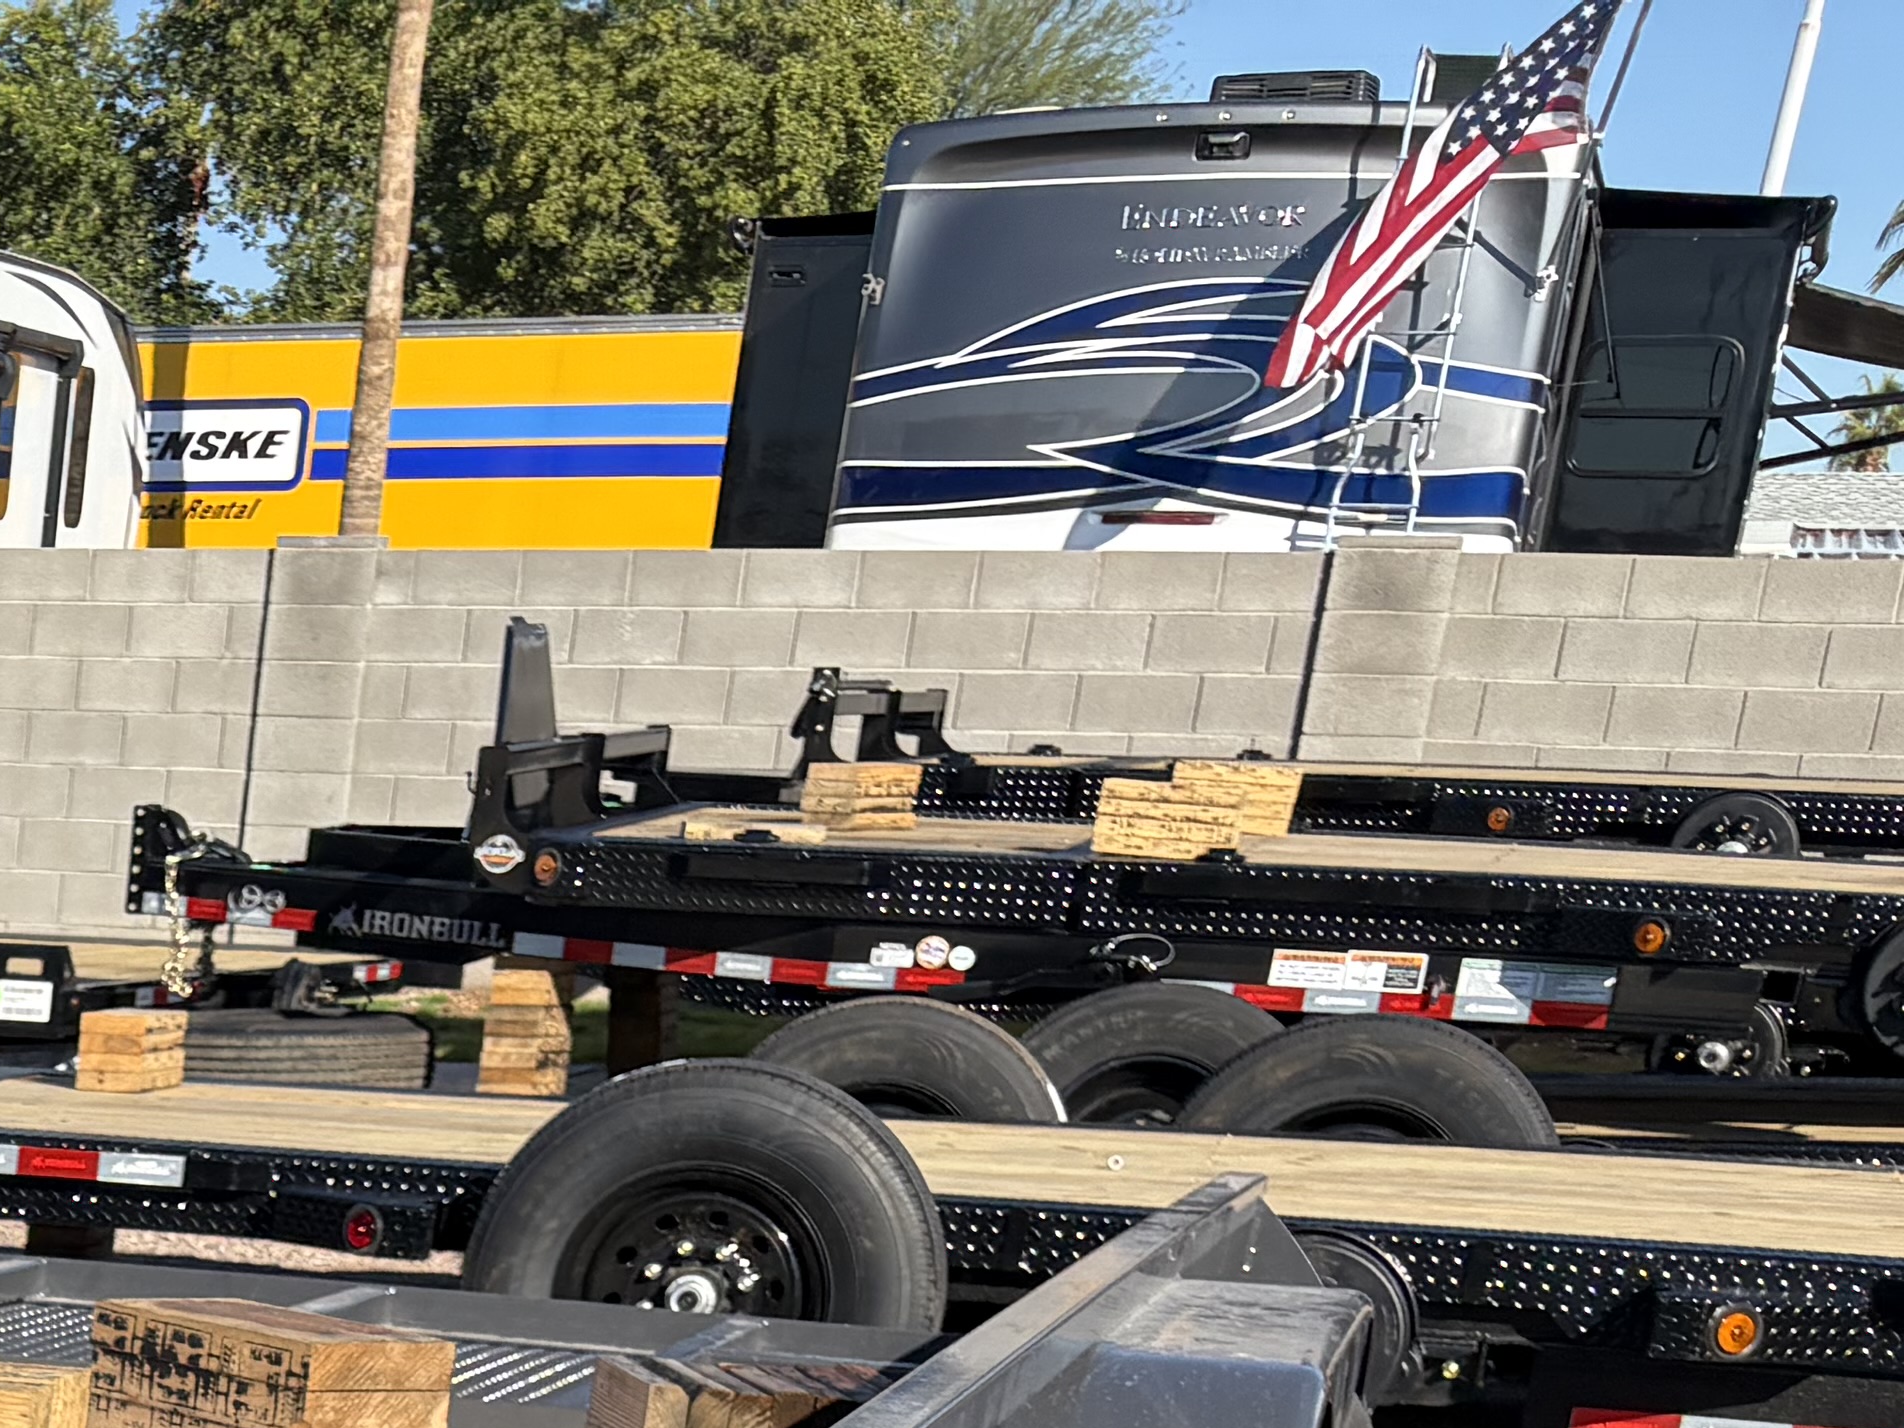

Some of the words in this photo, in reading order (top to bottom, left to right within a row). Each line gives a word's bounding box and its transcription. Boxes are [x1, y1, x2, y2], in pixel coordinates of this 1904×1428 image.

[146, 430, 290, 461] ENSKE
[185, 498, 262, 519] Rental
[363, 909, 505, 948] IRONBULL
